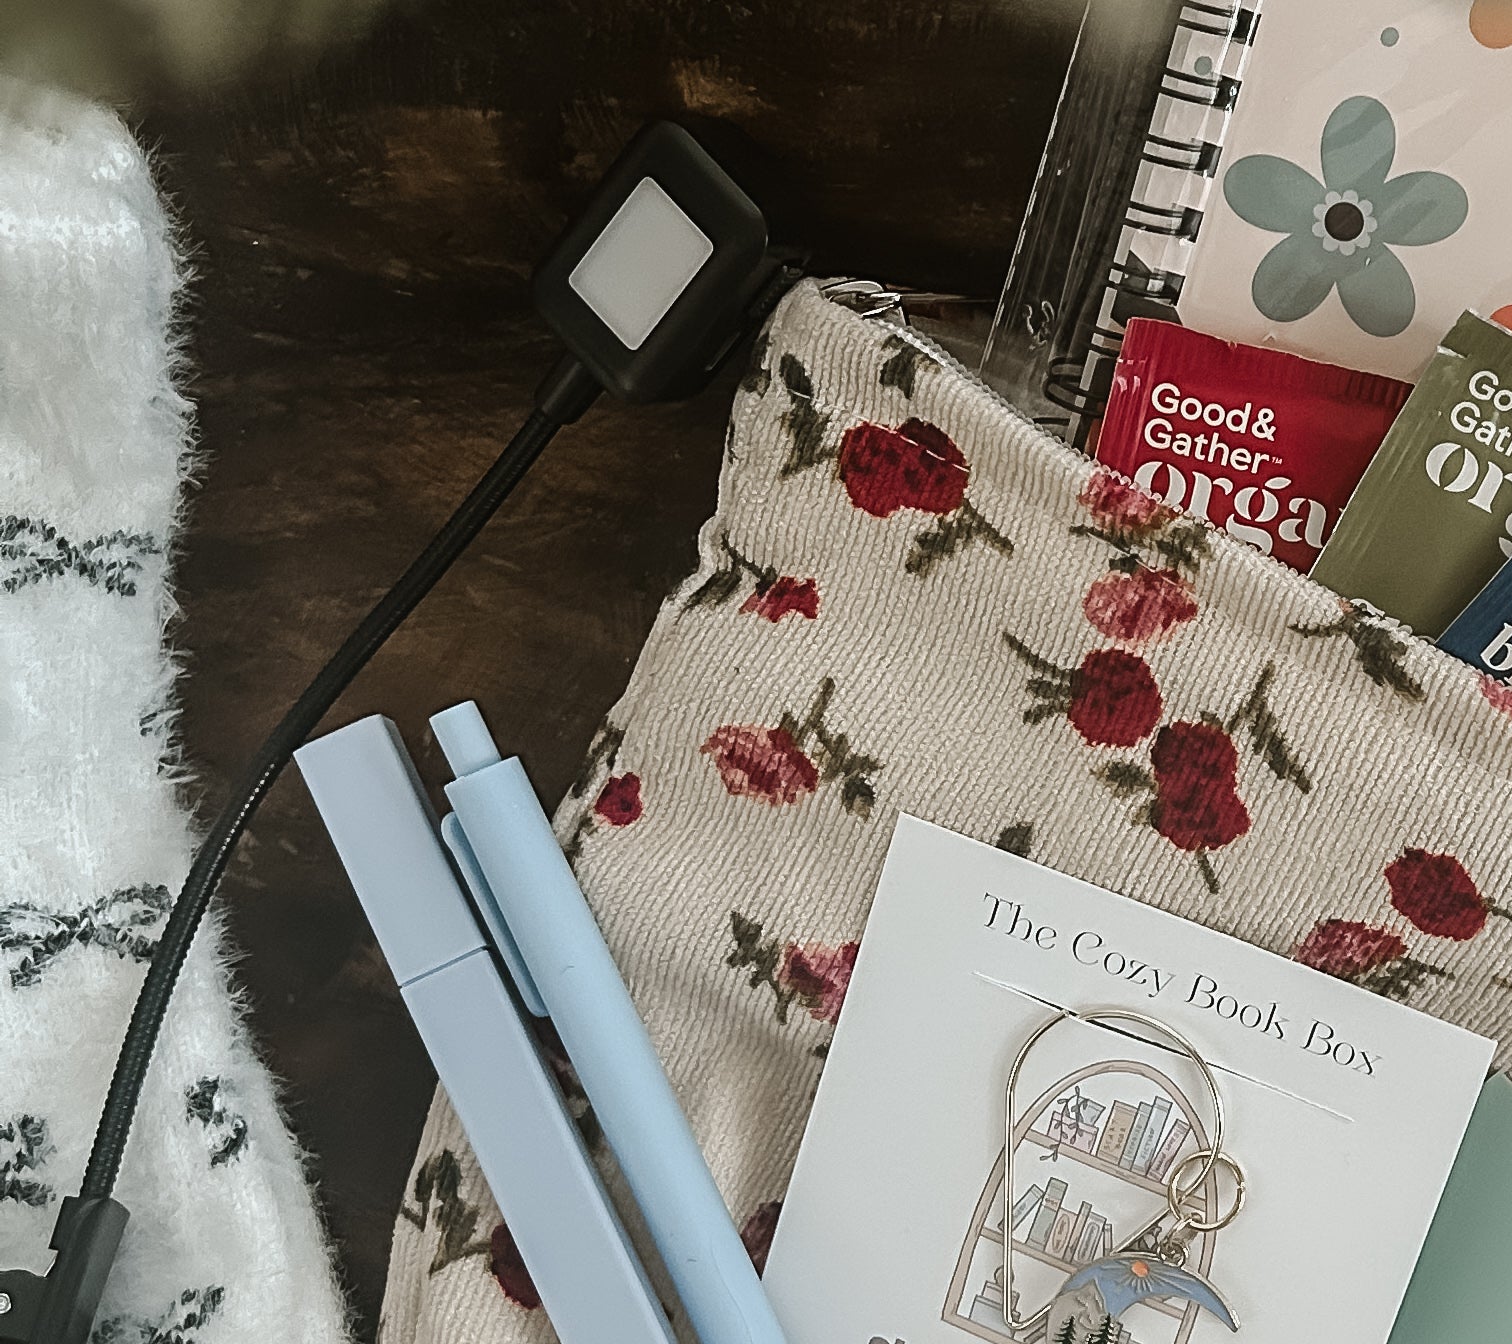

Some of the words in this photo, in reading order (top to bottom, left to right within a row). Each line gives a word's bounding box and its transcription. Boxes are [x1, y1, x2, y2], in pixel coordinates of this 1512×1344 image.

[982, 892, 1059, 951] The
[1072, 930, 1177, 999] Cozy
[1184, 971, 1293, 1041] Book
[1299, 1017, 1384, 1077] Box
